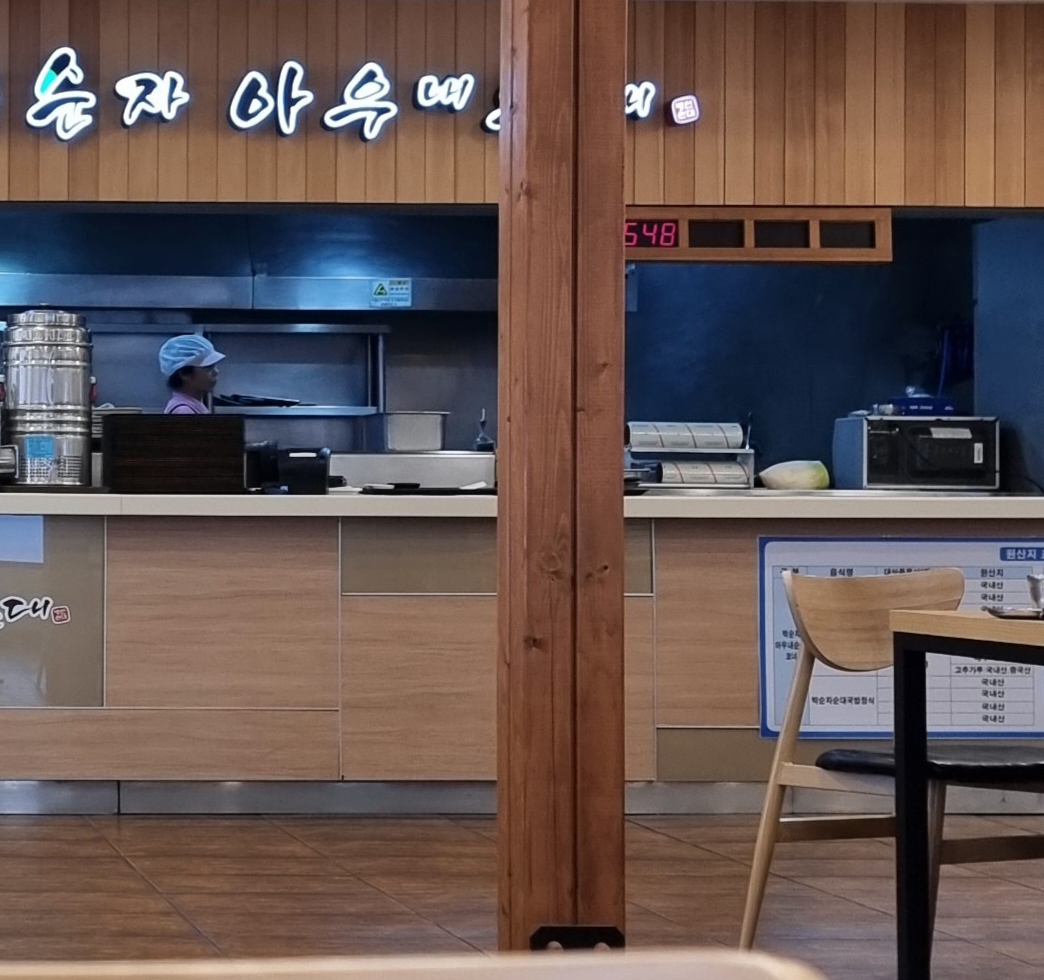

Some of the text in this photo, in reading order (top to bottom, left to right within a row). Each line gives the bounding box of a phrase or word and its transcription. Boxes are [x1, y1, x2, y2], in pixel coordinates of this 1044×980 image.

[981, 581, 1004, 590] 국내산
[981, 593, 1004, 602] 국내산
[982, 678, 1005, 687] 국내산
[982, 689, 1005, 698] 국내산
[982, 703, 1005, 712] 국내산
[982, 715, 1005, 724] 국내산
